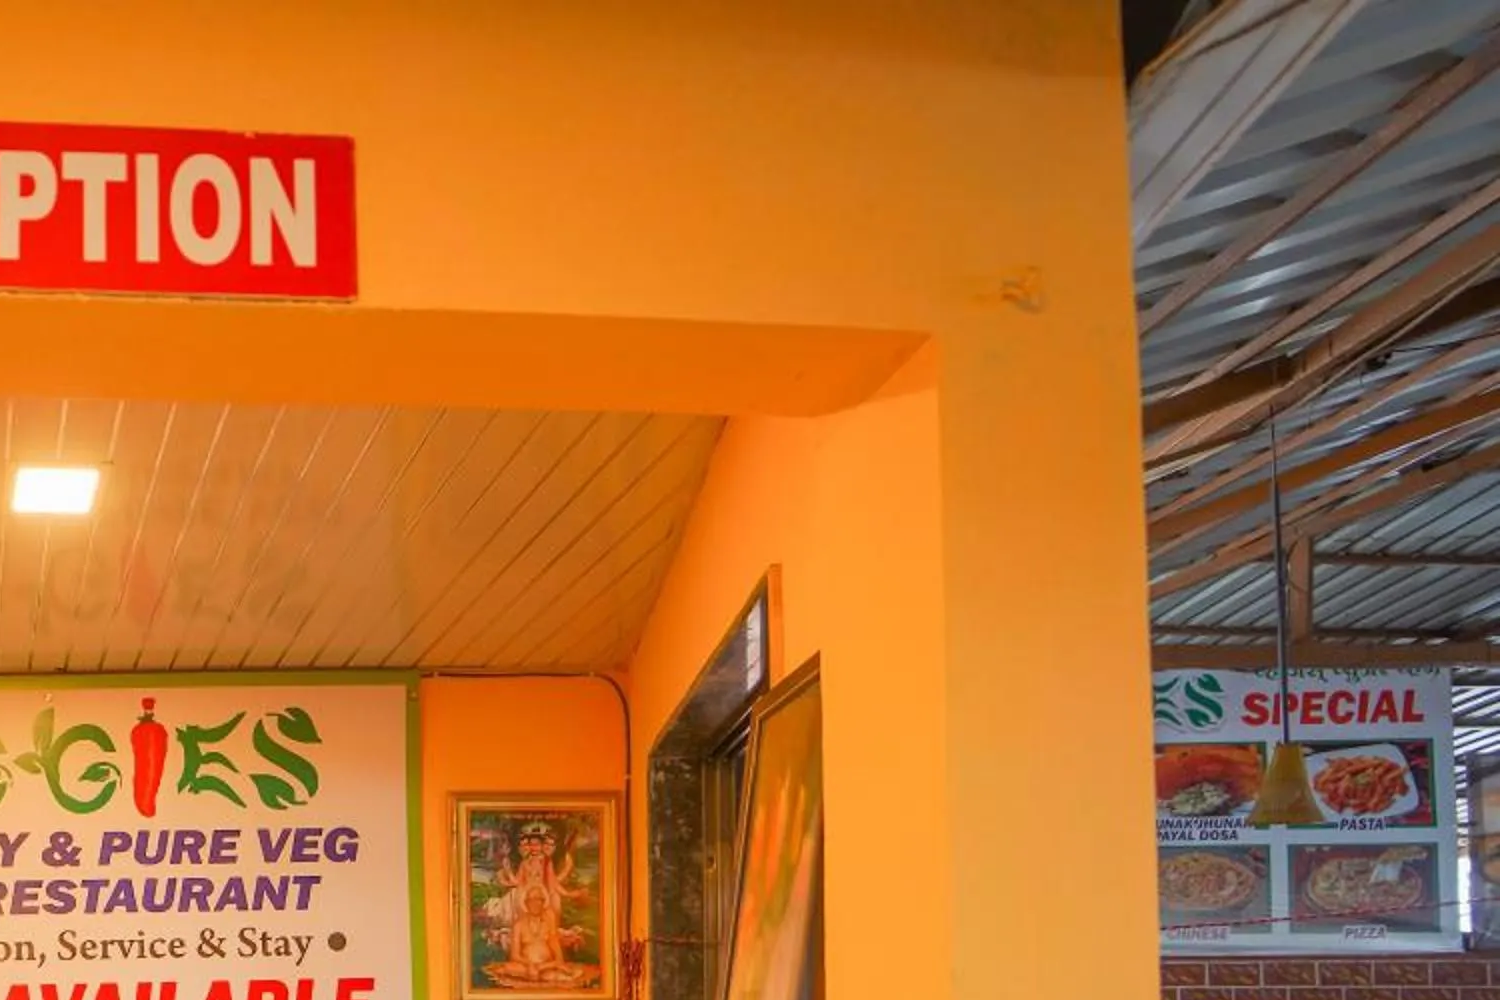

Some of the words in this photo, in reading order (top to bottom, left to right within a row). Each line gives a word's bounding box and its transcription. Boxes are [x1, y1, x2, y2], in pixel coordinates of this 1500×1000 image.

[1241, 689, 1425, 727] SPECIAL
[1199, 829, 1239, 841] DOSA
[1339, 818, 1386, 831] PASTA
[40, 830, 83, 868] &
[98, 829, 241, 866] PURE
[257, 826, 360, 863] VEG
[56, 929, 185, 962] Service
[196, 927, 227, 960] &
[238, 925, 314, 965] Stay
[1345, 927, 1387, 940] PIZZA
